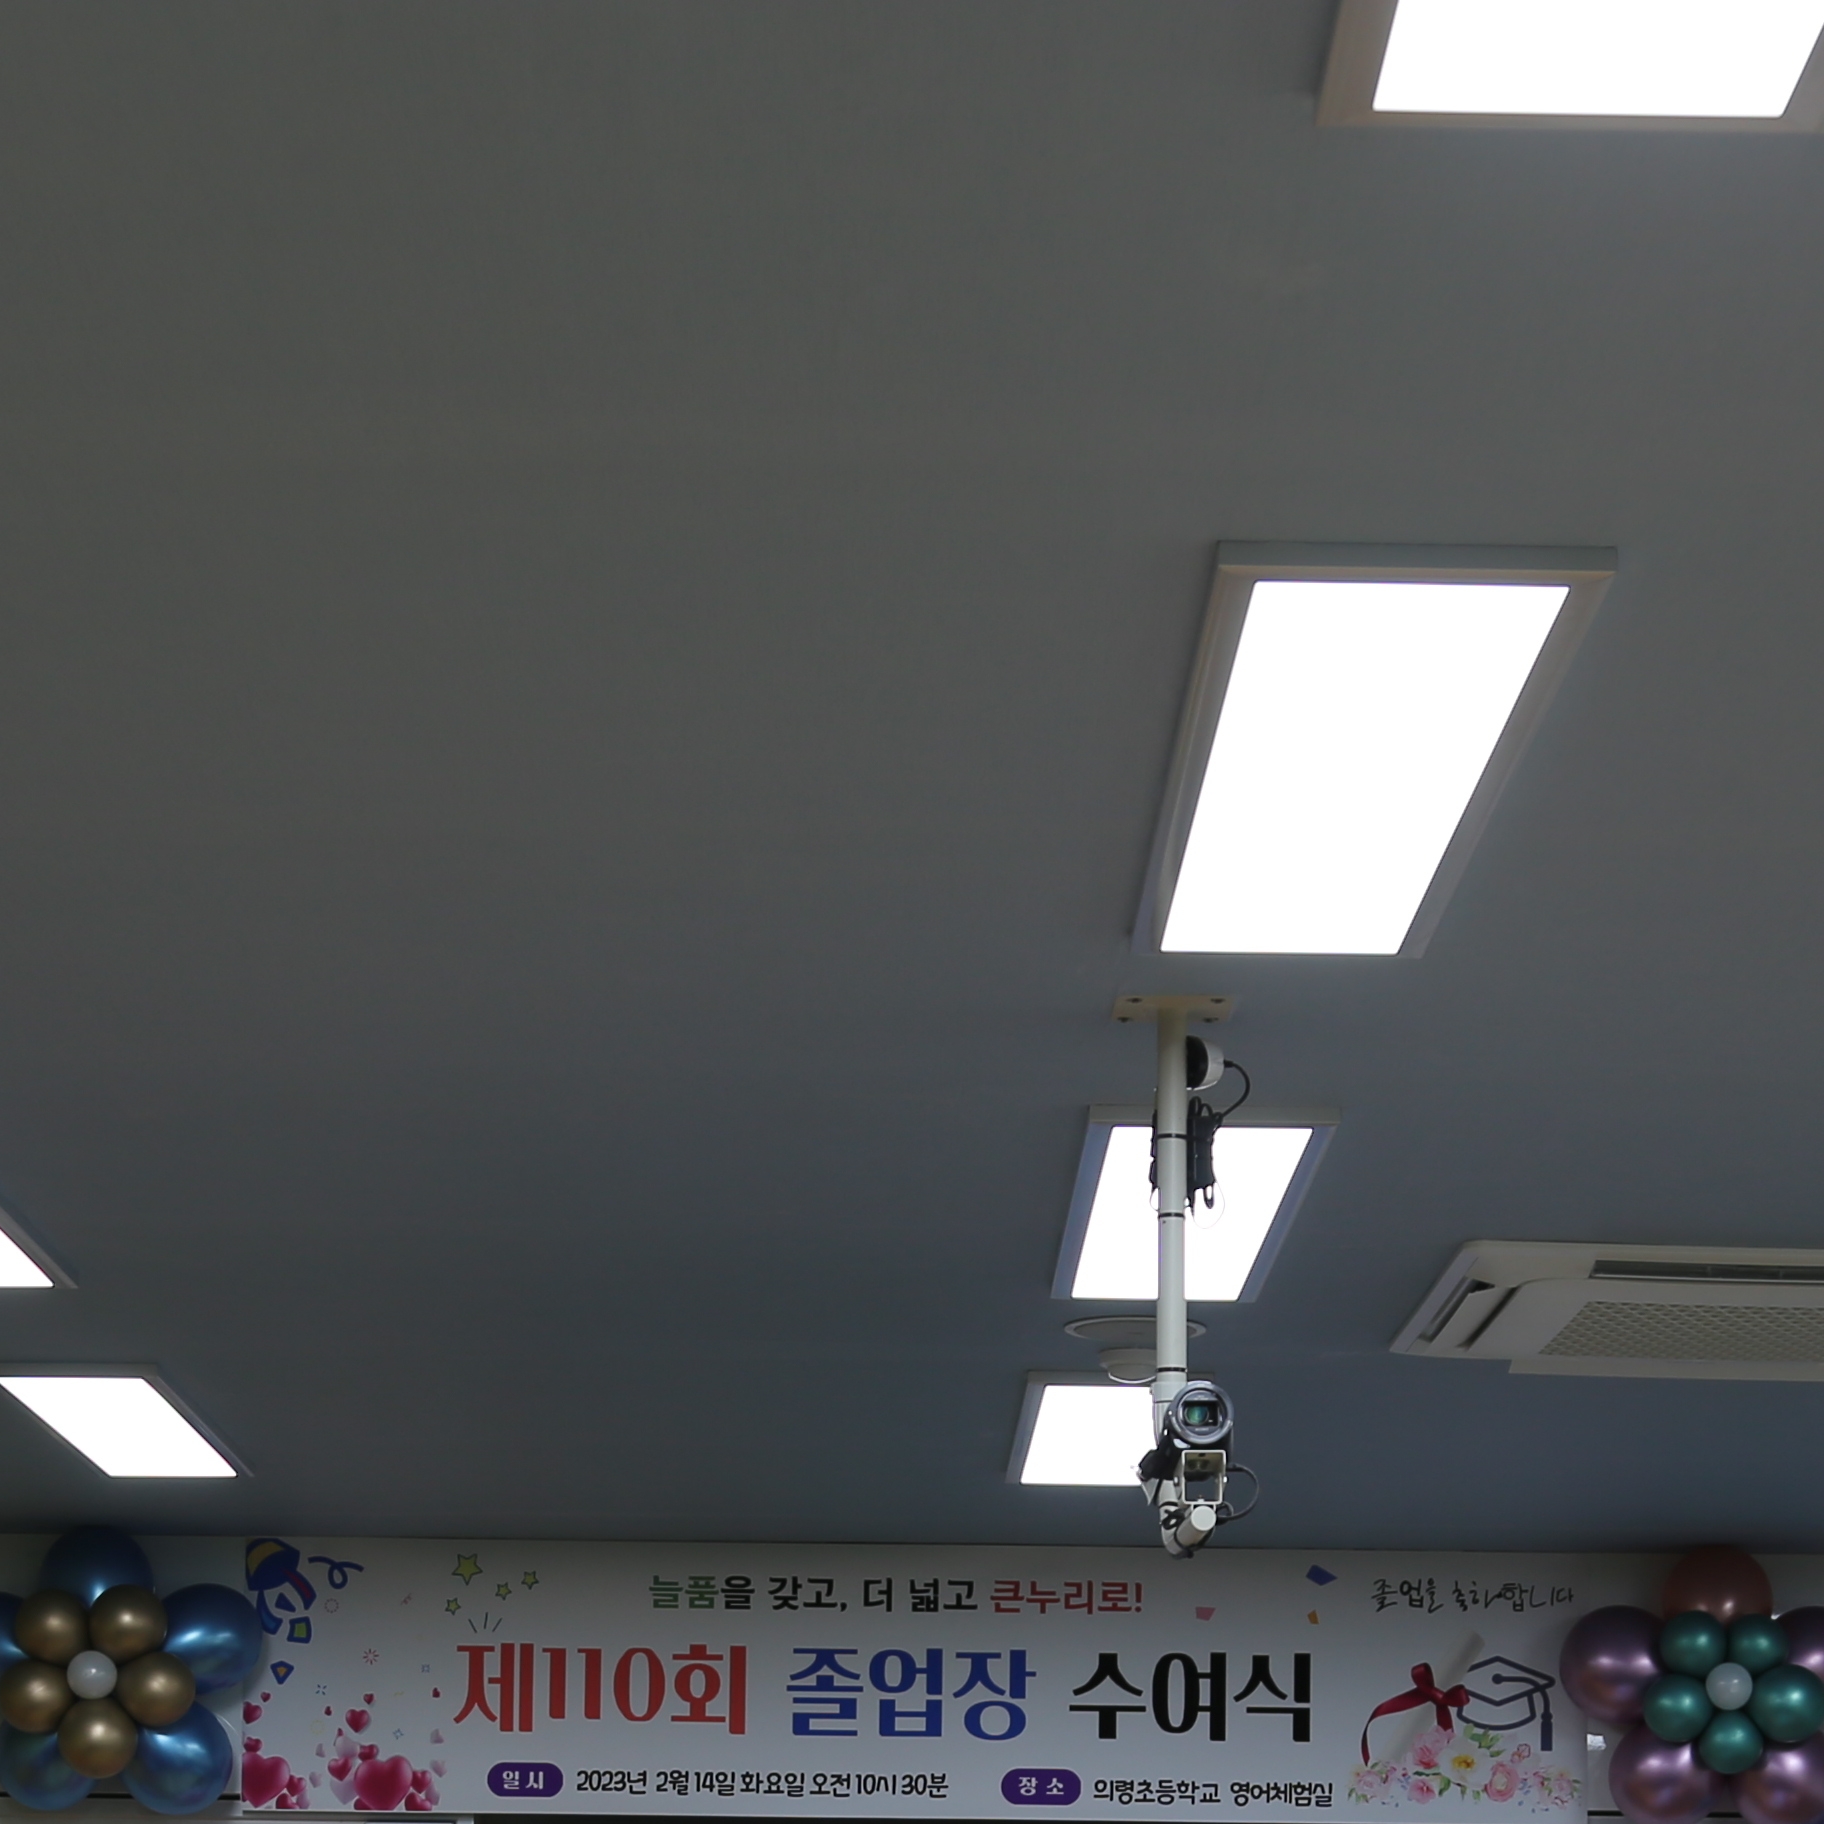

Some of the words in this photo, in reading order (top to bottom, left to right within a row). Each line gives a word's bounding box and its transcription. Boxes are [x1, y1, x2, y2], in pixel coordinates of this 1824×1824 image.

[649, 1575, 756, 1611] 늘품을
[768, 1576, 848, 1613] 갖고,
[863, 1577, 893, 1613] 더
[909, 1578, 978, 1613] 넓고
[990, 1580, 1143, 1615] 큰누리로!
[1371, 1578, 1444, 1613] 졸업을
[453, 1641, 749, 1736] 제110회
[785, 1646, 1037, 1741] 졸업장
[1067, 1650, 1312, 1744] 수여식
[576, 1769, 648, 1795] 2023년
[655, 1770, 690, 1797] 2월
[693, 1771, 736, 1797] 14일
[739, 1771, 806, 1799] 화요일
[808, 1772, 852, 1799] 오전
[855, 1773, 898, 1797] 10시
[900, 1773, 950, 1800] 30분
[1092, 1779, 1222, 1806] 의령초등학교
[1229, 1781, 1334, 1808] 영어체험실
